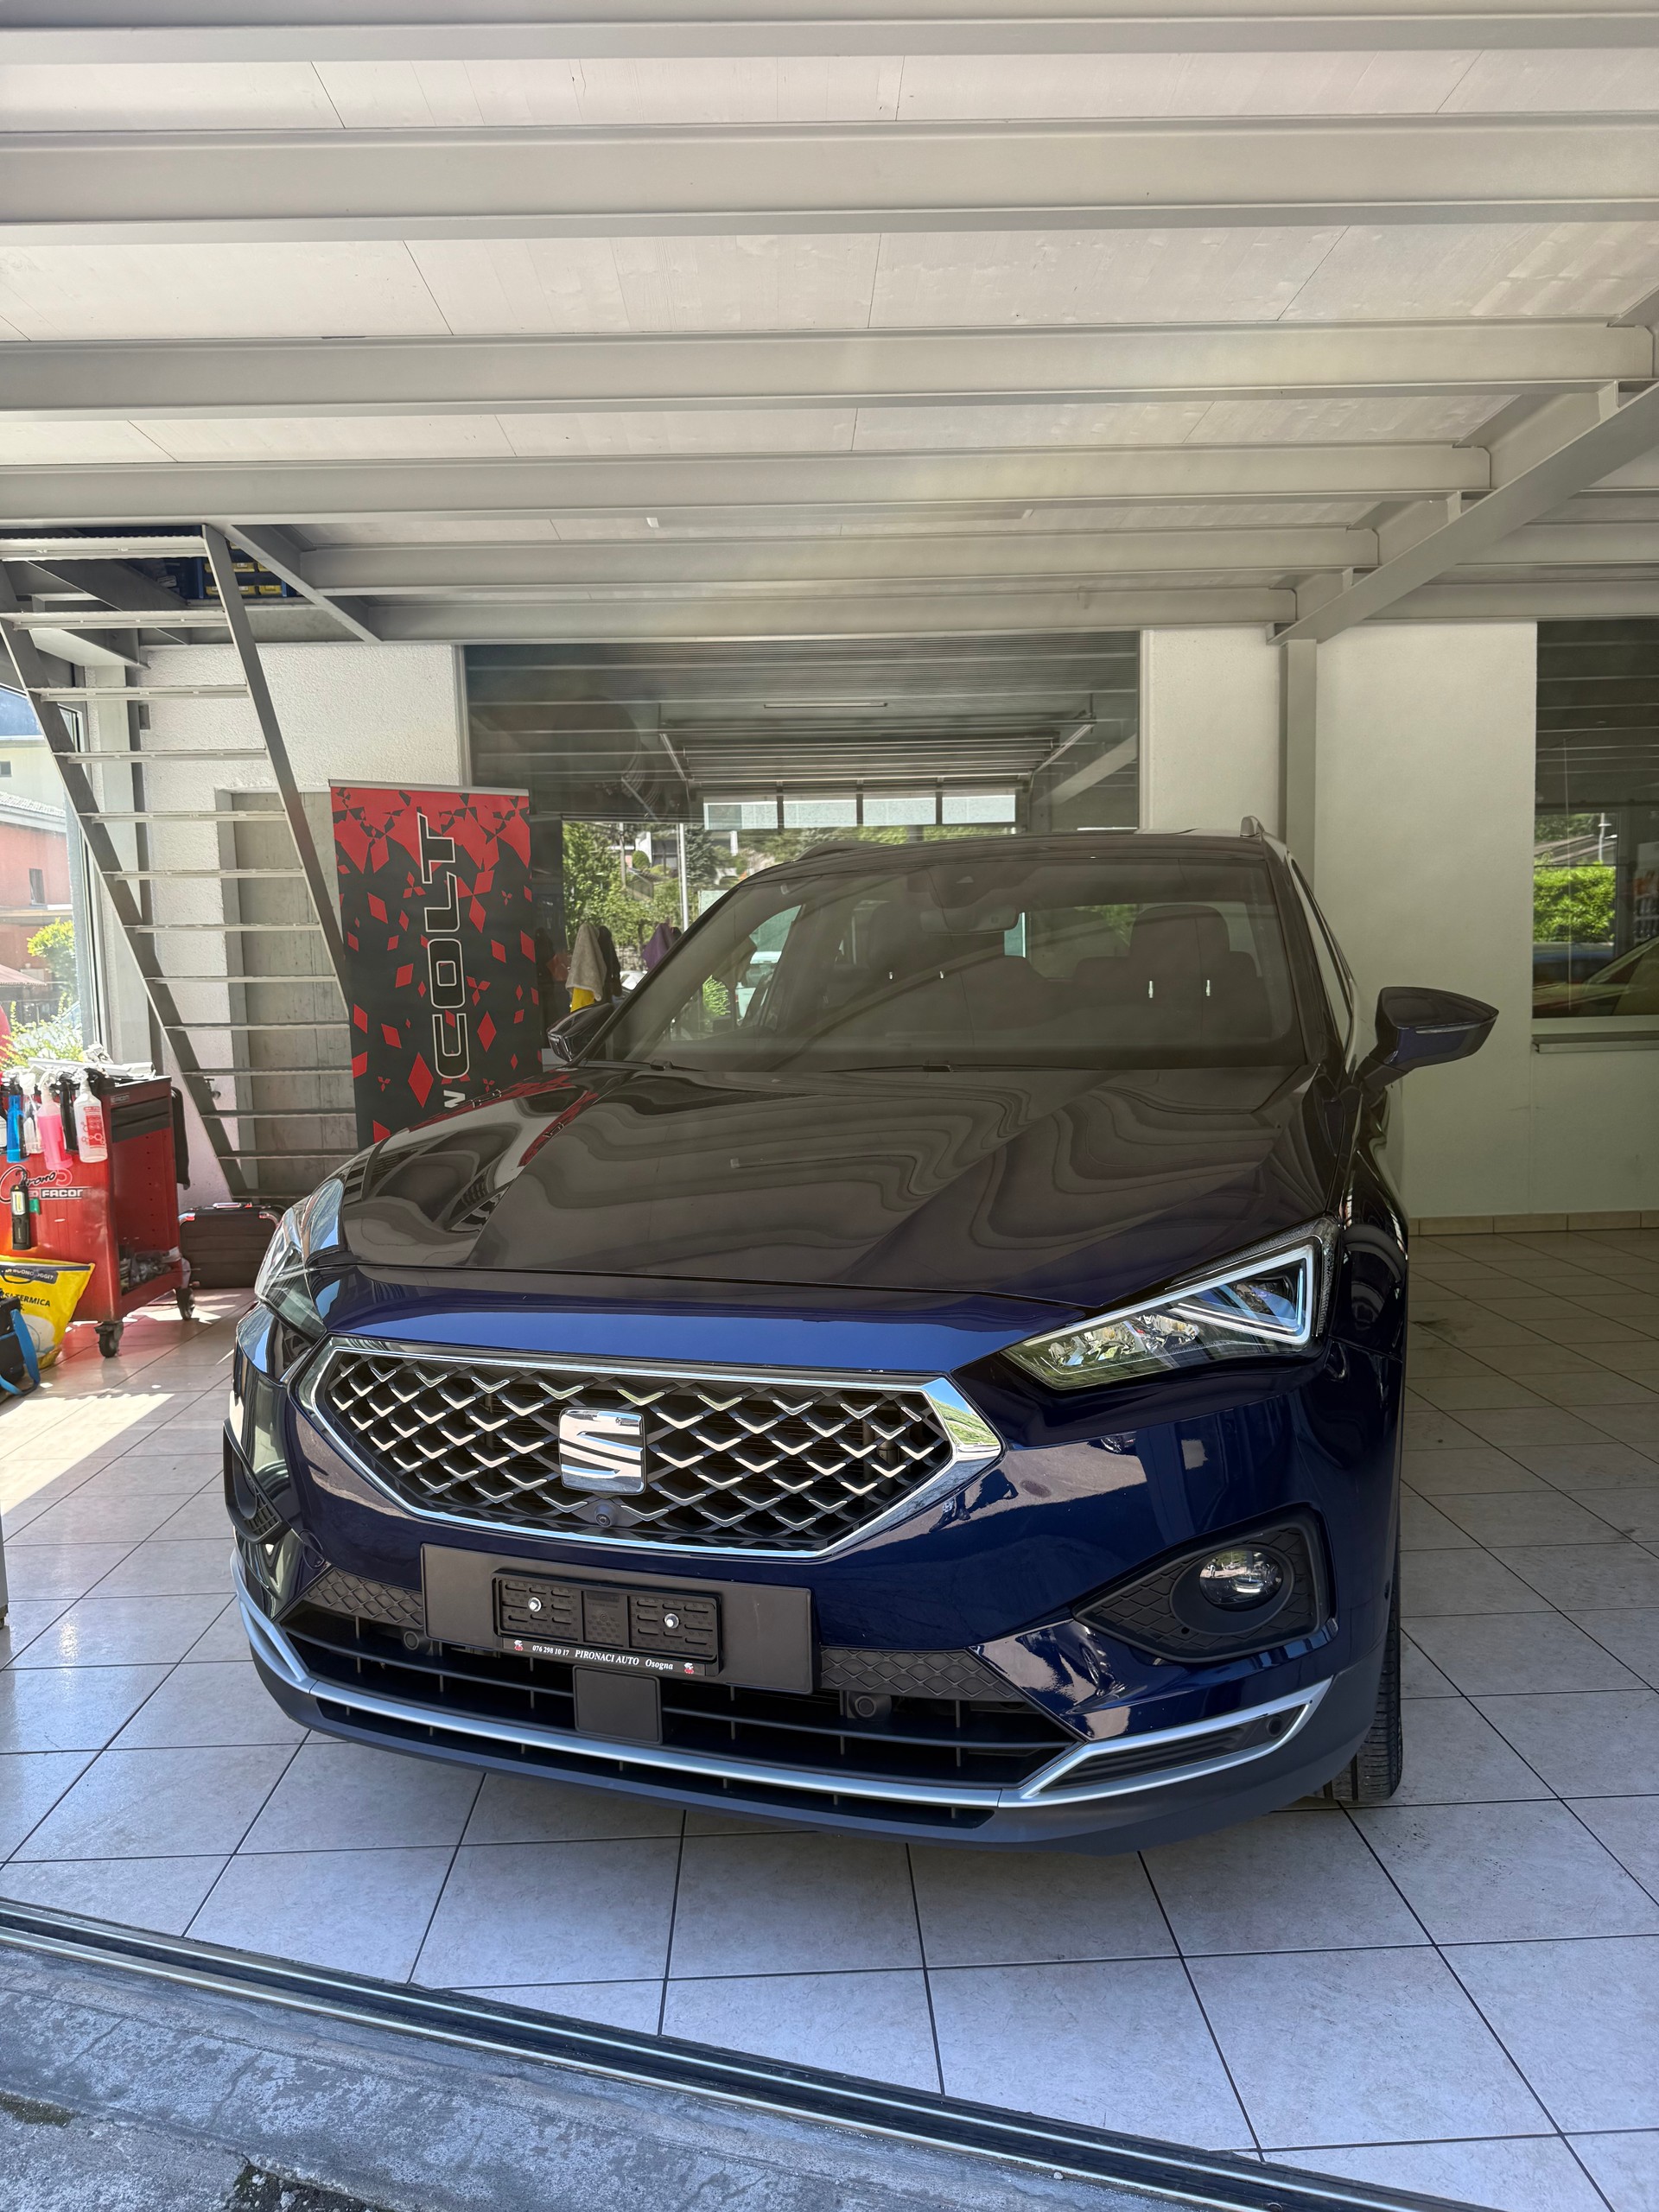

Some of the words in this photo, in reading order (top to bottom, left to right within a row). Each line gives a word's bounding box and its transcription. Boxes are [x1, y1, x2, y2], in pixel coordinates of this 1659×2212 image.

[416, 812, 470, 1079] COLT
[0, 1165, 57, 1204] Crono
[575, 1649, 615, 1662] PIRONACI
[615, 1656, 639, 1666] AUTO
[645, 1658, 674, 1670] Osogna
